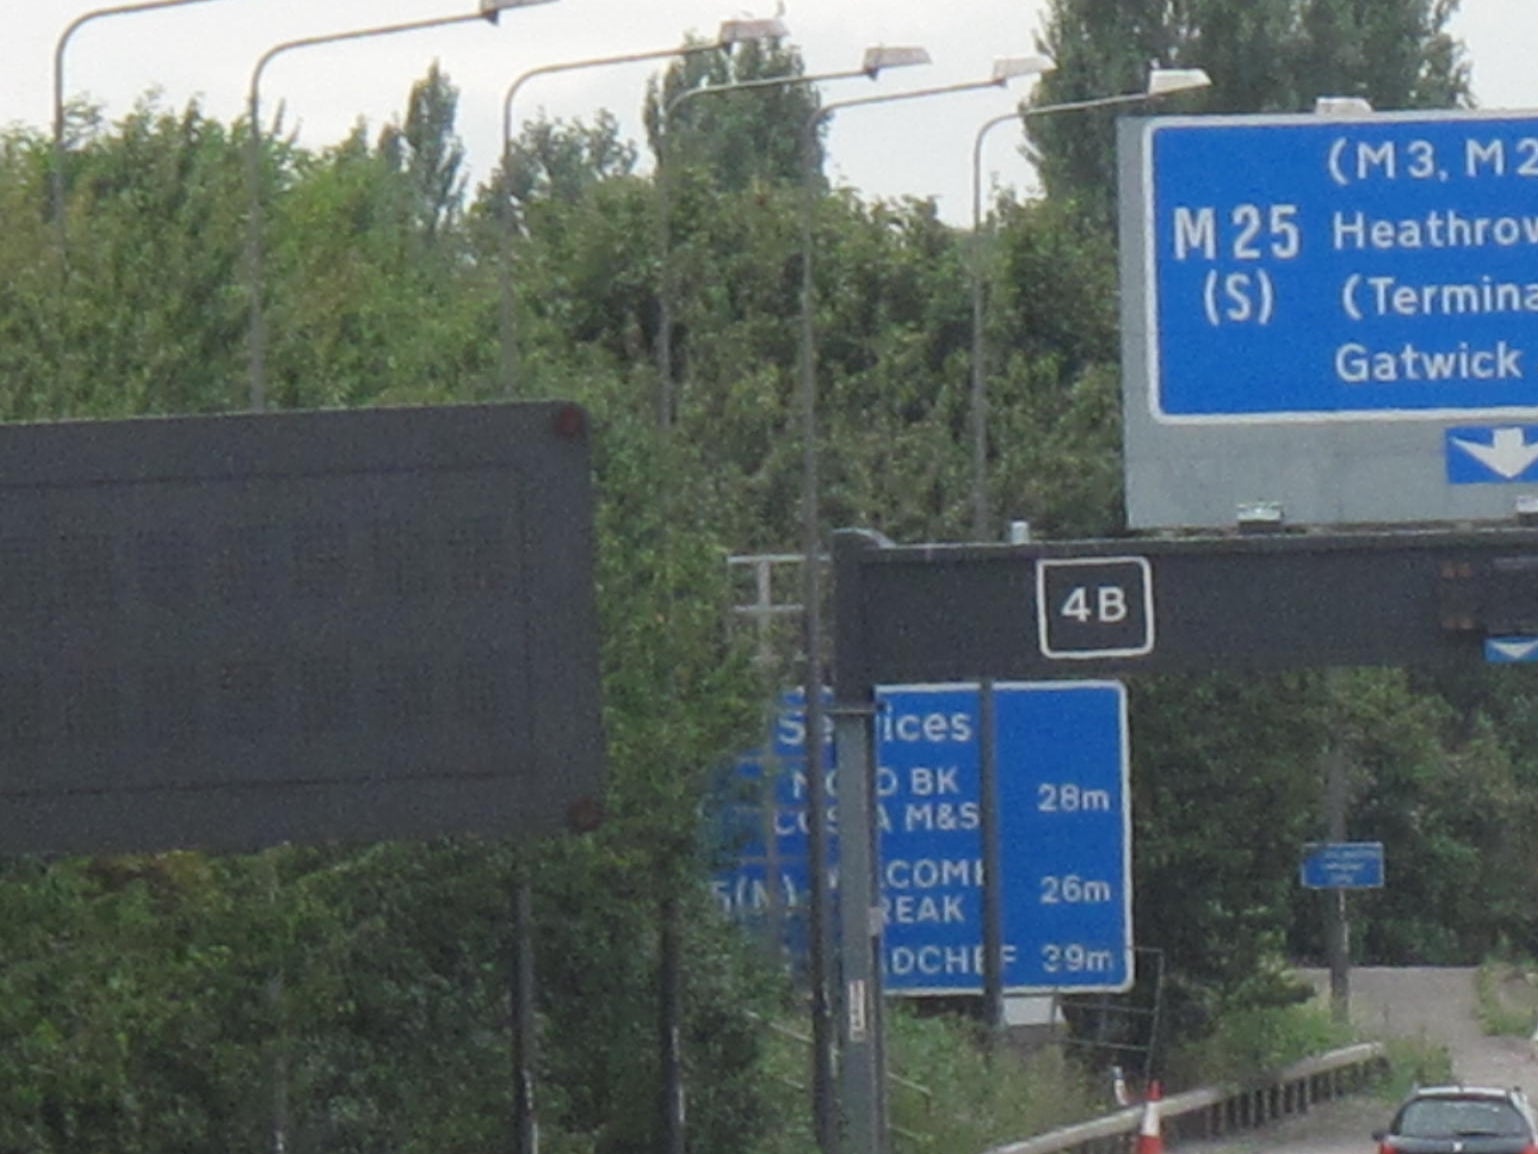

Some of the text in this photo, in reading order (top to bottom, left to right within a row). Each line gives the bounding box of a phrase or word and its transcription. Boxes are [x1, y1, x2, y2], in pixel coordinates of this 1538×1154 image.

[1329, 138, 1448, 186] (M3,
[1174, 205, 1300, 260] M25
[1205, 270, 1273, 326] (S)
[1336, 341, 1522, 383] Gatwick
[1062, 586, 1127, 623] 4B
[911, 768, 959, 796] BK
[1038, 784, 1110, 813] 28m
[905, 801, 981, 832] M&S
[1040, 874, 1111, 904] 26m
[1042, 944, 1113, 973] 39m
